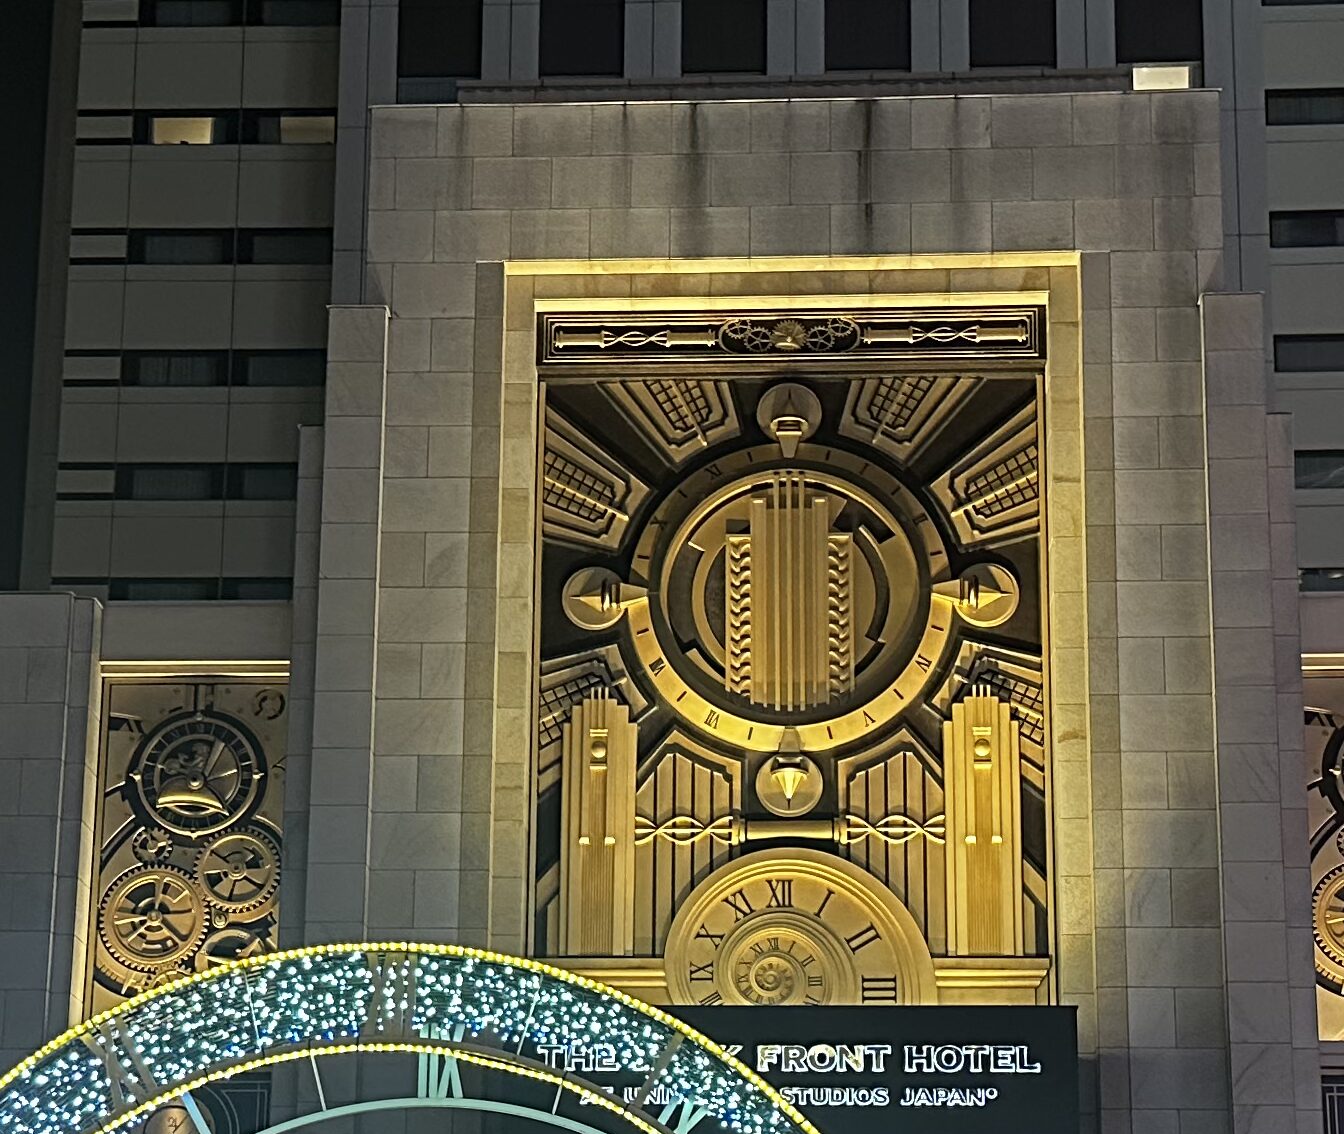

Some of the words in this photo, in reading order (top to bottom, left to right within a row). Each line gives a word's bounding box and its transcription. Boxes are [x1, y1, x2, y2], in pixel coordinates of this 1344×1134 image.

[722, 888, 756, 923] XI
[765, 879, 794, 908] XII
[814, 888, 836, 919] I
[694, 923, 726, 950] X
[843, 921, 882, 955] II
[757, 1045, 891, 1073] FRONT
[904, 1045, 1042, 1074] HOTEL
[779, 1086, 890, 1107] STUDIOS
